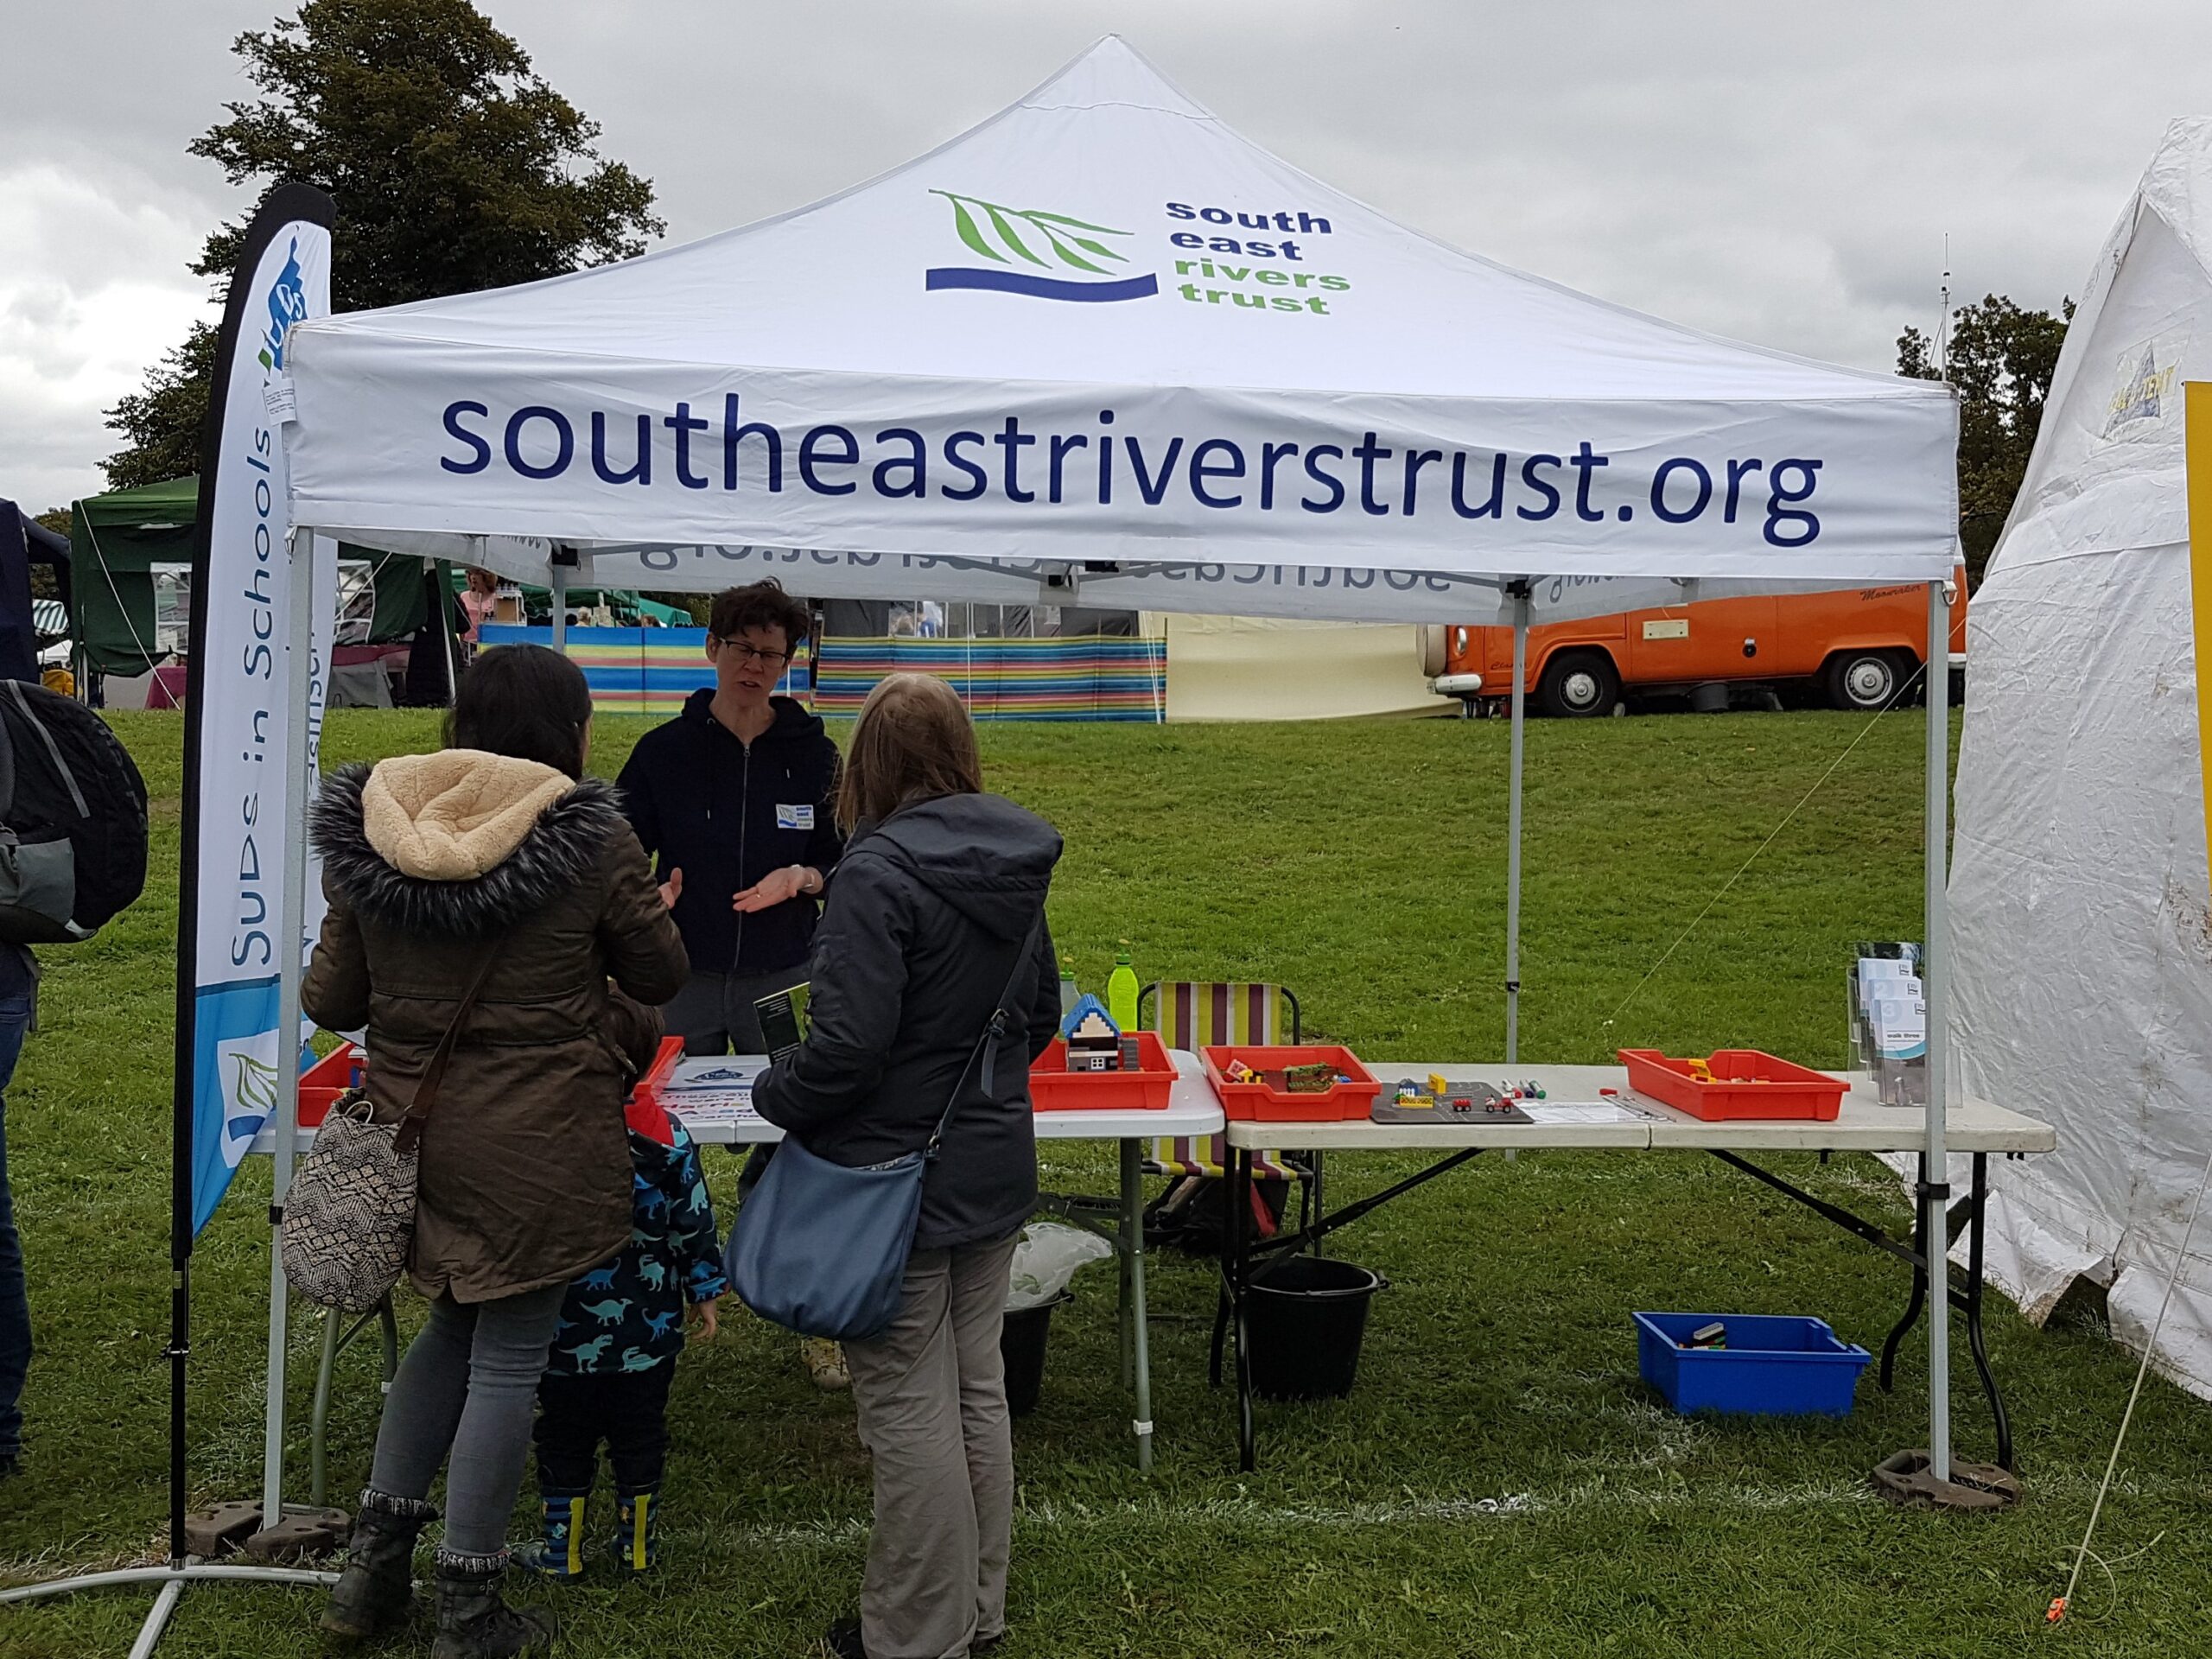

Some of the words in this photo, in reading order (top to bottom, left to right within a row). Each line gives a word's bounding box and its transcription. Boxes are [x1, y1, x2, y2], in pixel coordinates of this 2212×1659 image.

[1166, 202, 1332, 233] south
[1170, 232, 1303, 261] east
[1174, 257, 1351, 290] rivers
[1178, 283, 1331, 315] trust
[441, 392, 1822, 547] southeastriverstrust.org
[244, 427, 273, 680] Schools
[243, 709, 269, 760] in
